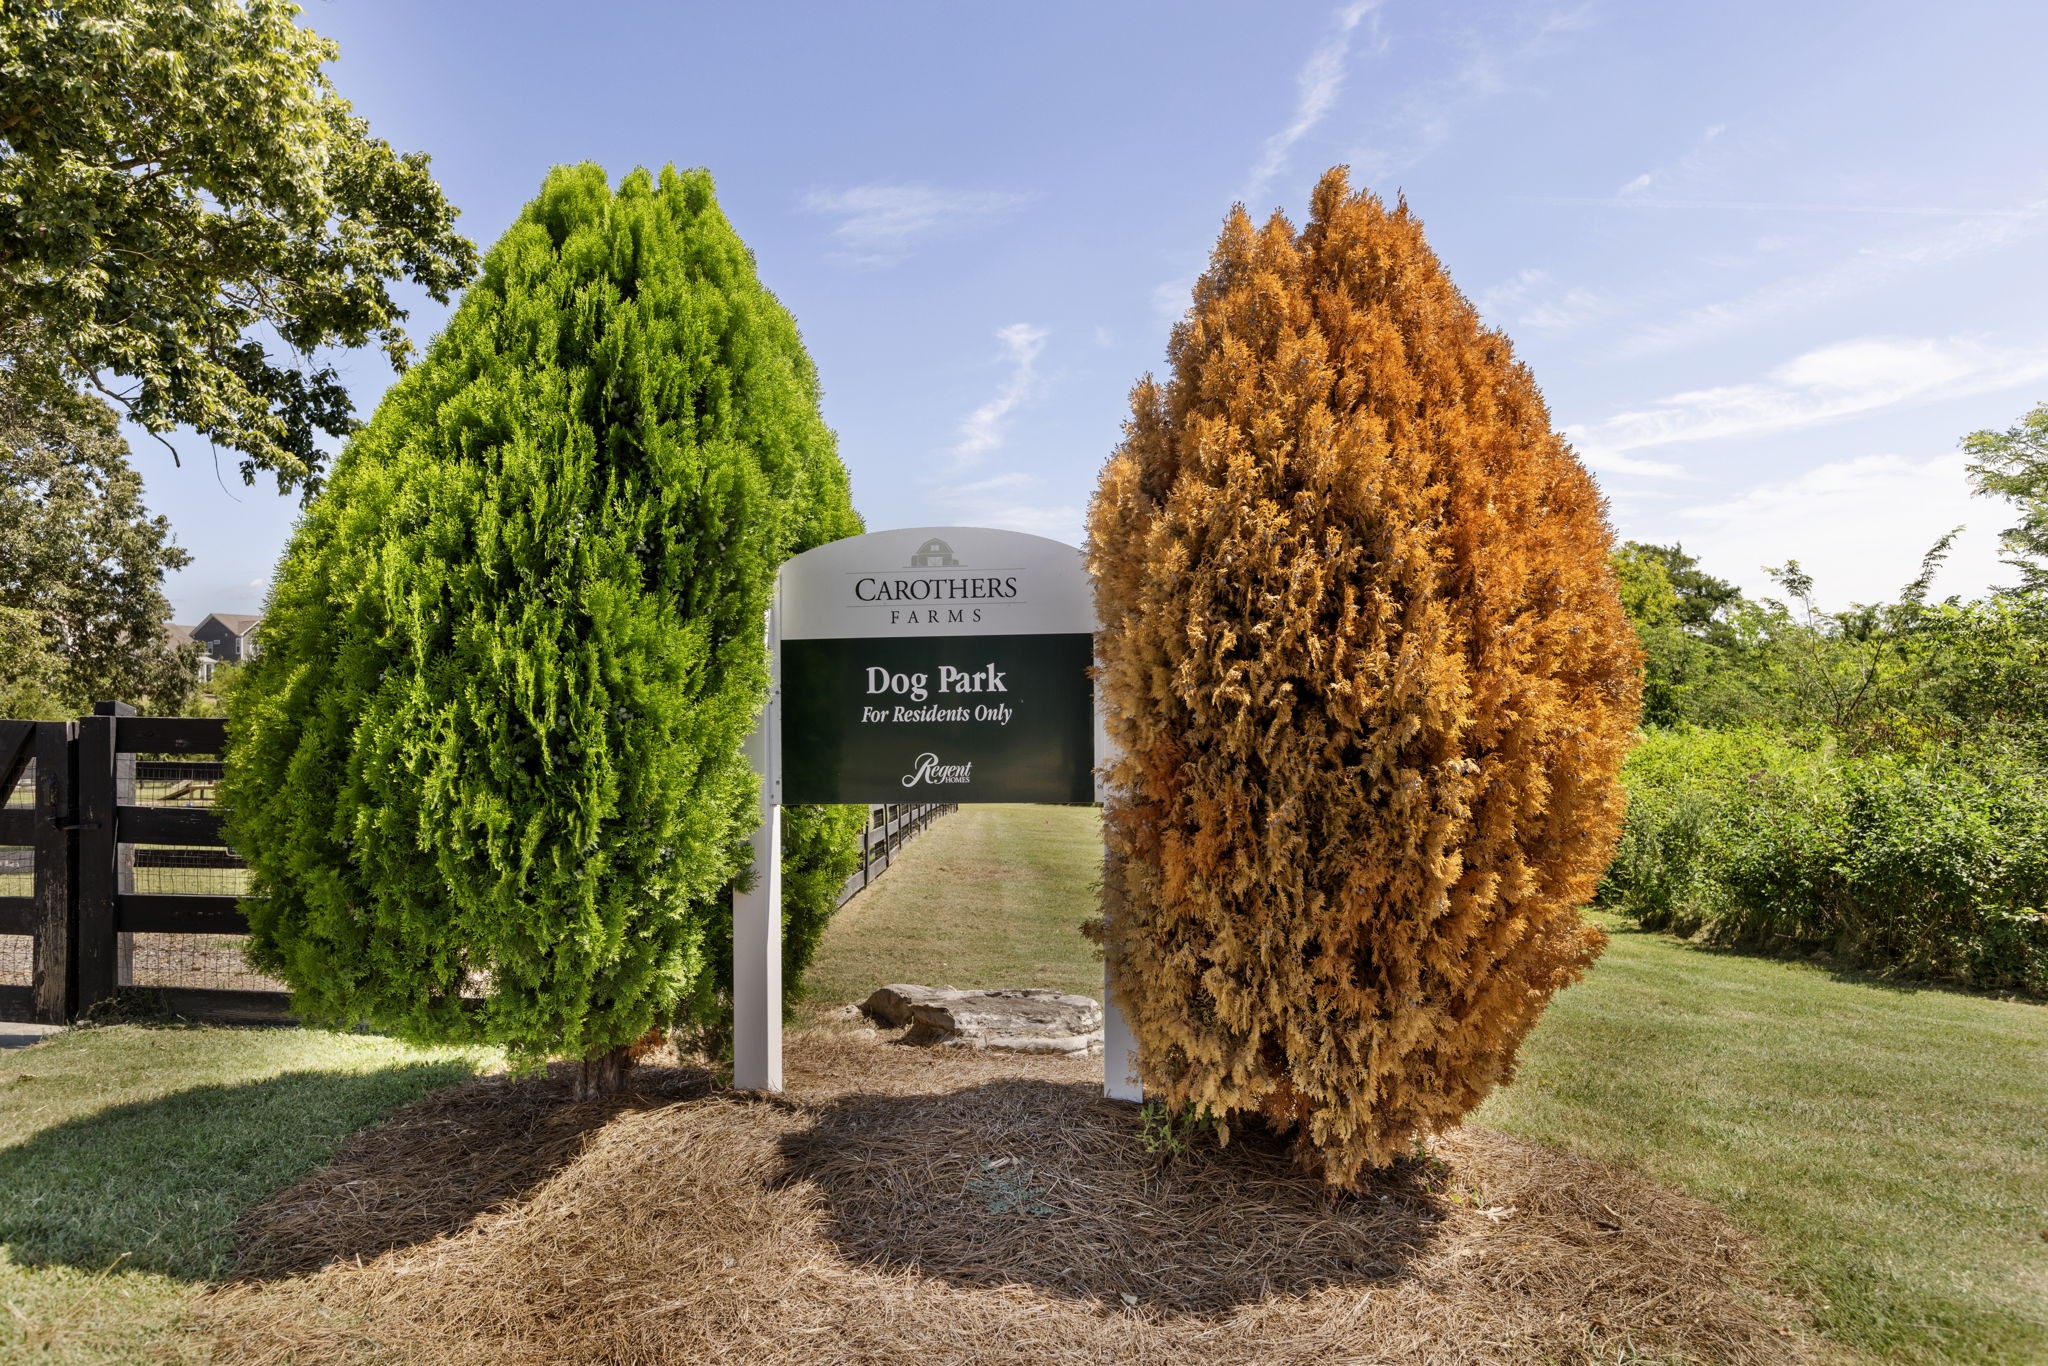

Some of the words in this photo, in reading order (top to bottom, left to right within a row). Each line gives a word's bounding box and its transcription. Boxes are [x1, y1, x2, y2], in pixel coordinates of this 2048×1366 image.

[855, 577, 1017, 601] CAROTHERS
[891, 608, 981, 624] FARMS
[866, 666, 928, 702] Dog
[938, 662, 1008, 693] Park
[861, 706, 889, 723] For
[893, 704, 970, 723] Residents
[974, 703, 1012, 725] Only
[902, 752, 972, 788] Regent
